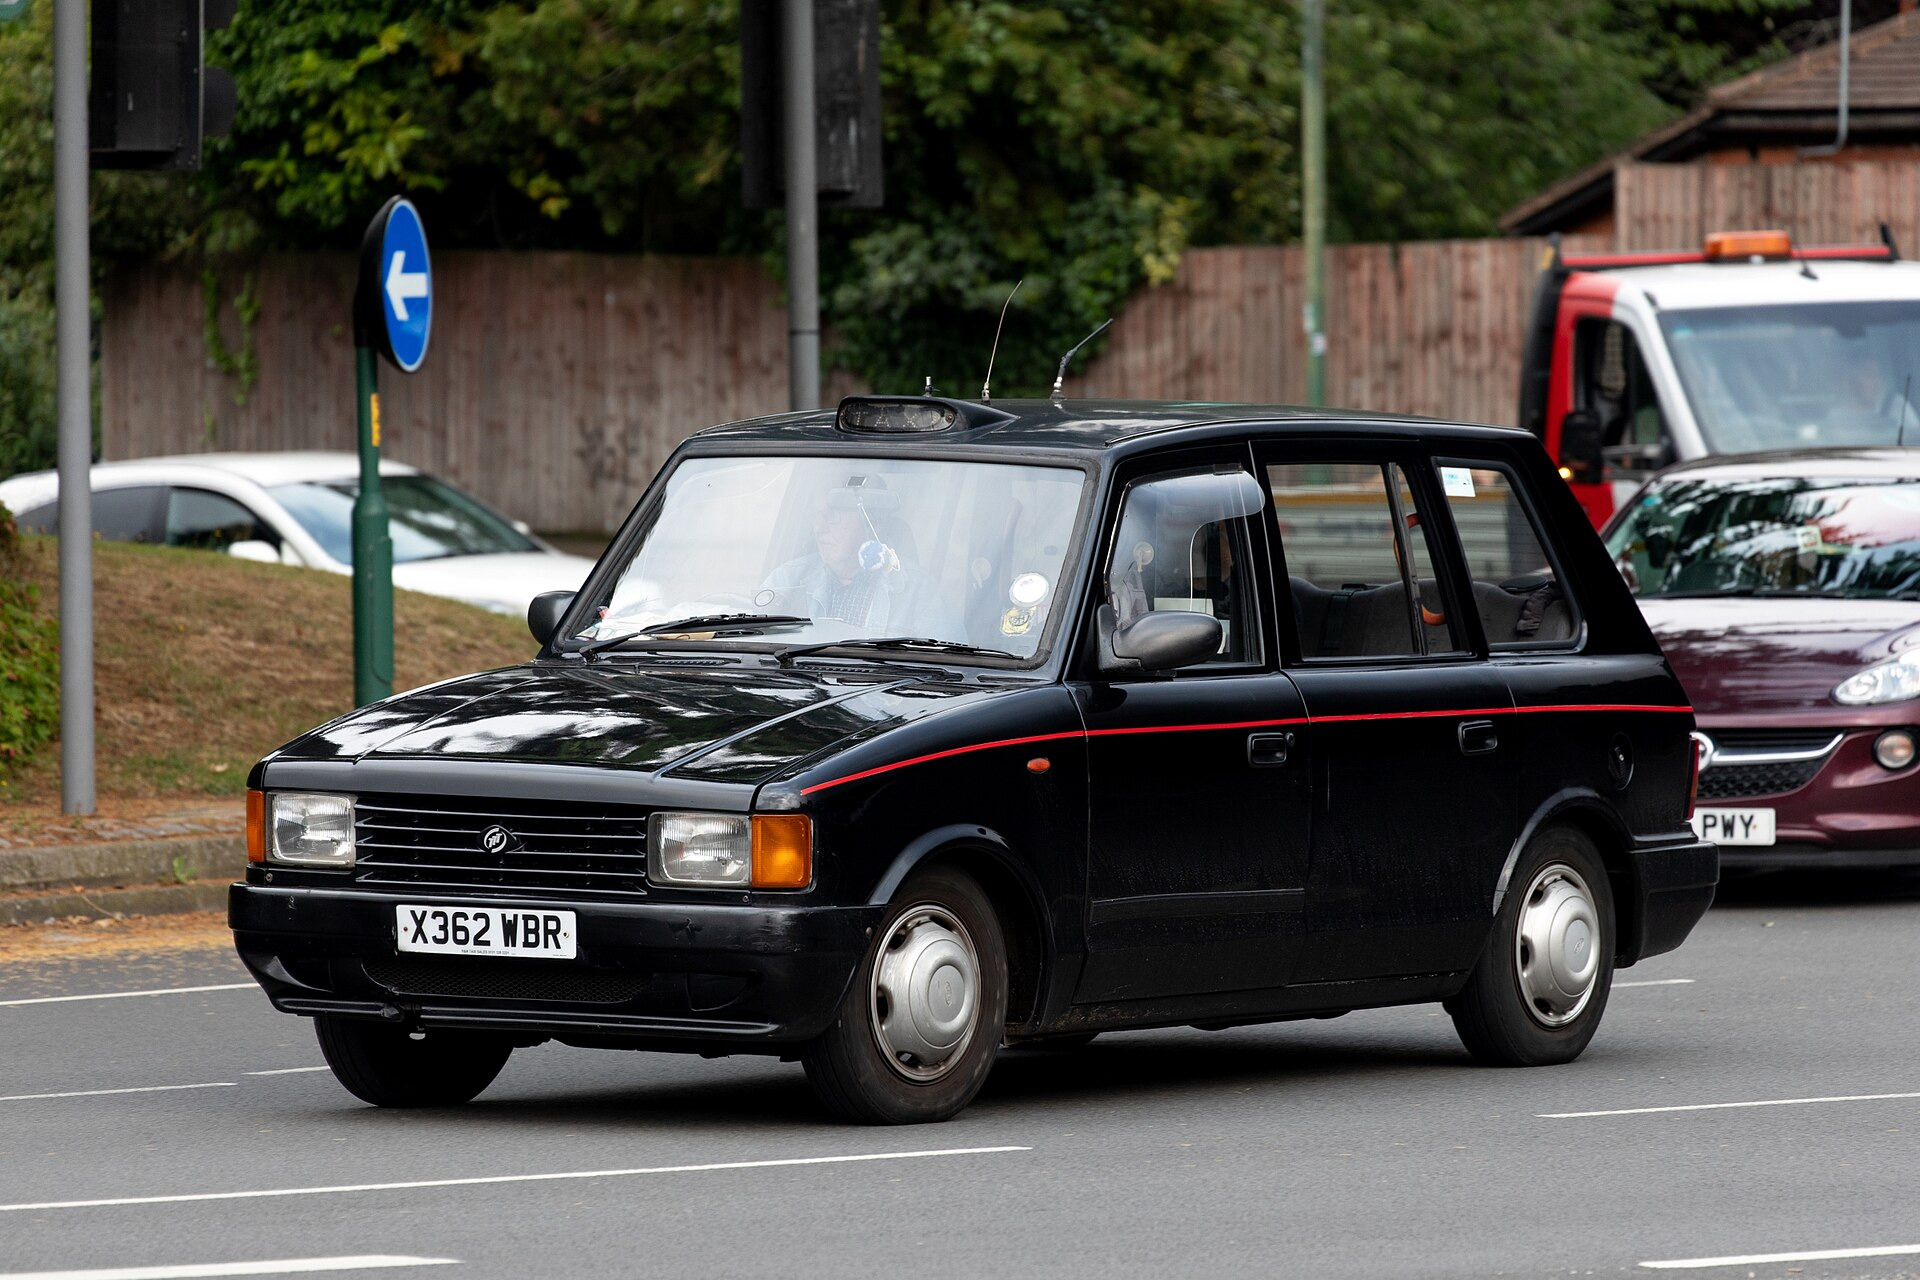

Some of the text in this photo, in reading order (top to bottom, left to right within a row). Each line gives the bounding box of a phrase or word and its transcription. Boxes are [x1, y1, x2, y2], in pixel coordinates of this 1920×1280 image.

[1702, 814, 1754, 839] PWY
[410, 910, 562, 950] X362 WBR
